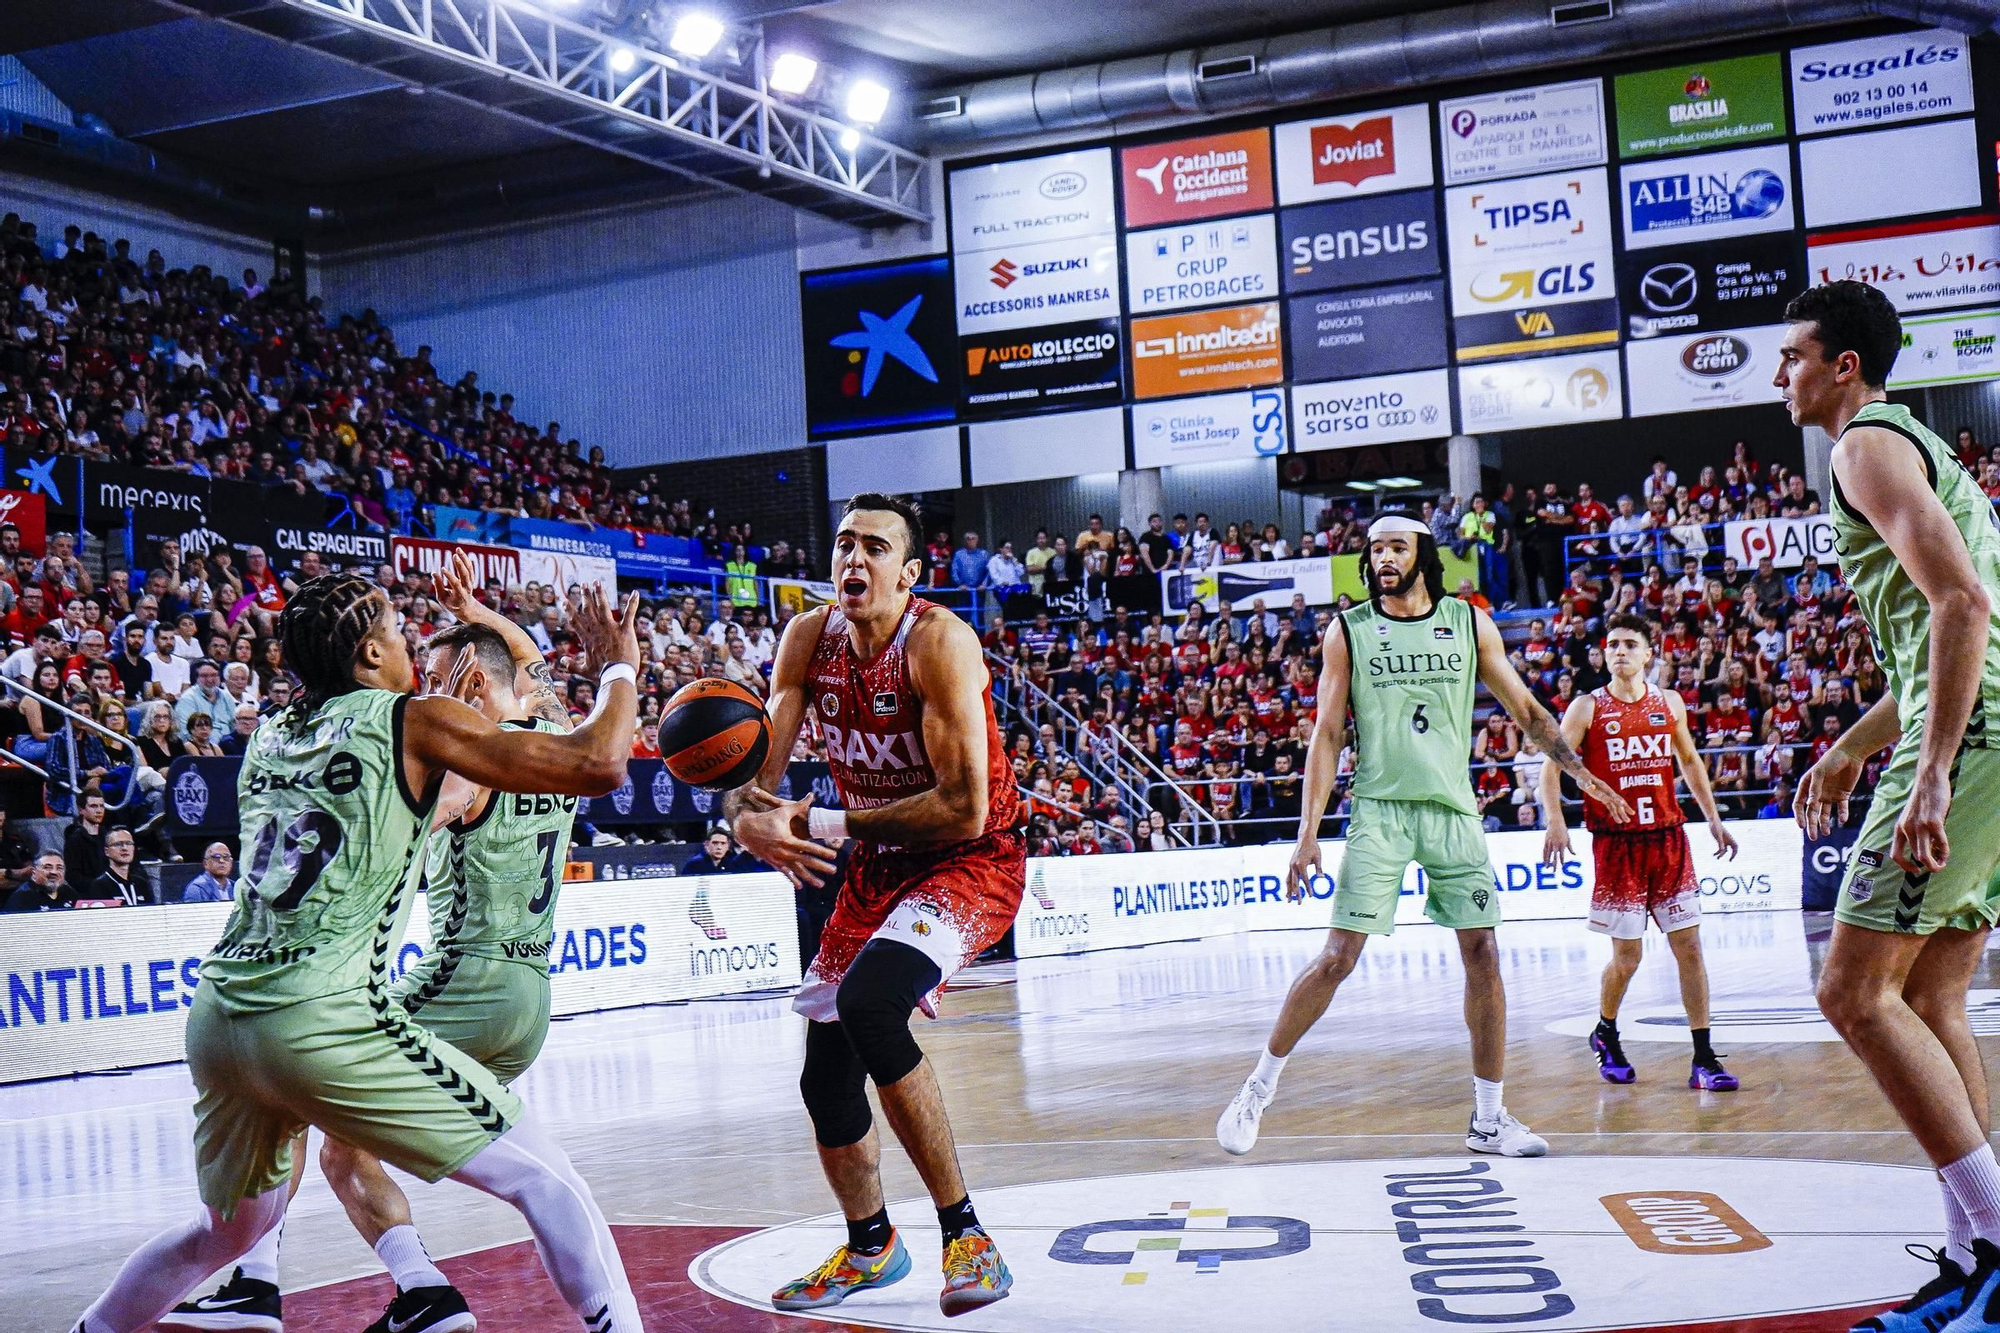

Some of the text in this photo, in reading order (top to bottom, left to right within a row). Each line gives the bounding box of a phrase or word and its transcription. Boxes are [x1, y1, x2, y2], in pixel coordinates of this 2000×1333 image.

[1800, 44, 1959, 82] Sagalés
[1833, 81, 1928, 106] 902 13 00 14
[1668, 98, 1729, 123] BRASILIA
[1814, 95, 1952, 124] www.sagales.com
[1172, 149, 1248, 175] Catalana
[1319, 137, 1384, 166] Joviat
[1173, 165, 1249, 192] Occident
[973, 210, 1090, 236] FULL TRACTION
[1483, 199, 1571, 230] TIPSA
[1291, 219, 1429, 266] sensus
[1023, 257, 1089, 277] SUZUKI
[1176, 257, 1228, 279] GRUP
[1537, 261, 1596, 296] GLS
[964, 287, 1110, 318] ACCESSORIS MANRESA
[1143, 274, 1265, 309] PETROBAGES
[1732, 288, 1750, 298] 877
[1766, 284, 1778, 295] 19
[1315, 298, 1376, 314] CONSULTORIA
[1317, 315, 1364, 331] ADVOCATS
[1648, 313, 1699, 331] mazda
[988, 333, 1116, 364] AUTOKOLECCIO
[1318, 332, 1366, 348] AUDITORIA
[1695, 337, 1734, 358] café
[1957, 344, 1993, 357] ROOM
[1179, 357, 1278, 378] www.innaltech.com
[1692, 353, 1739, 371] crem
[1304, 391, 1403, 417] movento
[1170, 426, 1240, 444] Sant Josep
[1306, 414, 1369, 436] sarsa
[275, 528, 386, 558] CAL SPAGUETTI
[1780, 523, 1836, 558] AIG
[1369, 652, 1463, 677] surne
[1372, 679, 1408, 689] seguros
[1411, 703, 1430, 734] 6
[821, 722, 924, 770] BAXI
[1605, 733, 1672, 762] BAXI
[1619, 773, 1664, 791] MANRESA
[175, 788, 209, 804] BAXI
[1637, 796, 1656, 825] 6
[527, 830, 560, 915] 3
[1859, 853, 1878, 866] acb
[920, 904, 937, 916] acb
[1113, 881, 1209, 917] PLANTILLES
[1211, 879, 1231, 908] 3D
[1030, 910, 1090, 940] inmoovs
[689, 941, 780, 978] inmoovs
[1383, 1161, 1577, 1325] CONTROL
